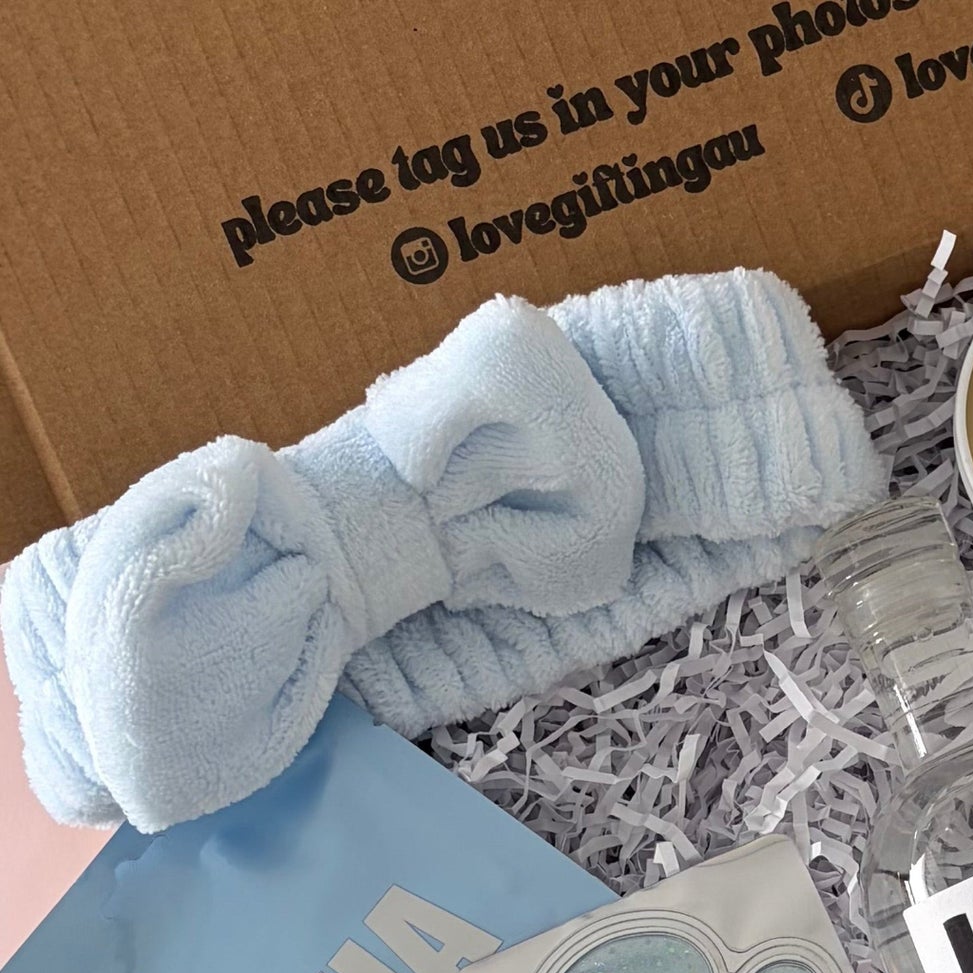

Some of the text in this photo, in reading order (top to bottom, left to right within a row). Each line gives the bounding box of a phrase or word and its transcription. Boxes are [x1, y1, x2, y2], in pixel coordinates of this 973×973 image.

[221, 169, 391, 268] please
[391, 145, 481, 188] tag
[480, 110, 548, 160] us
[546, 84, 615, 135] in
[615, 37, 741, 125] your
[447, 124, 766, 262] lovegiftingau
